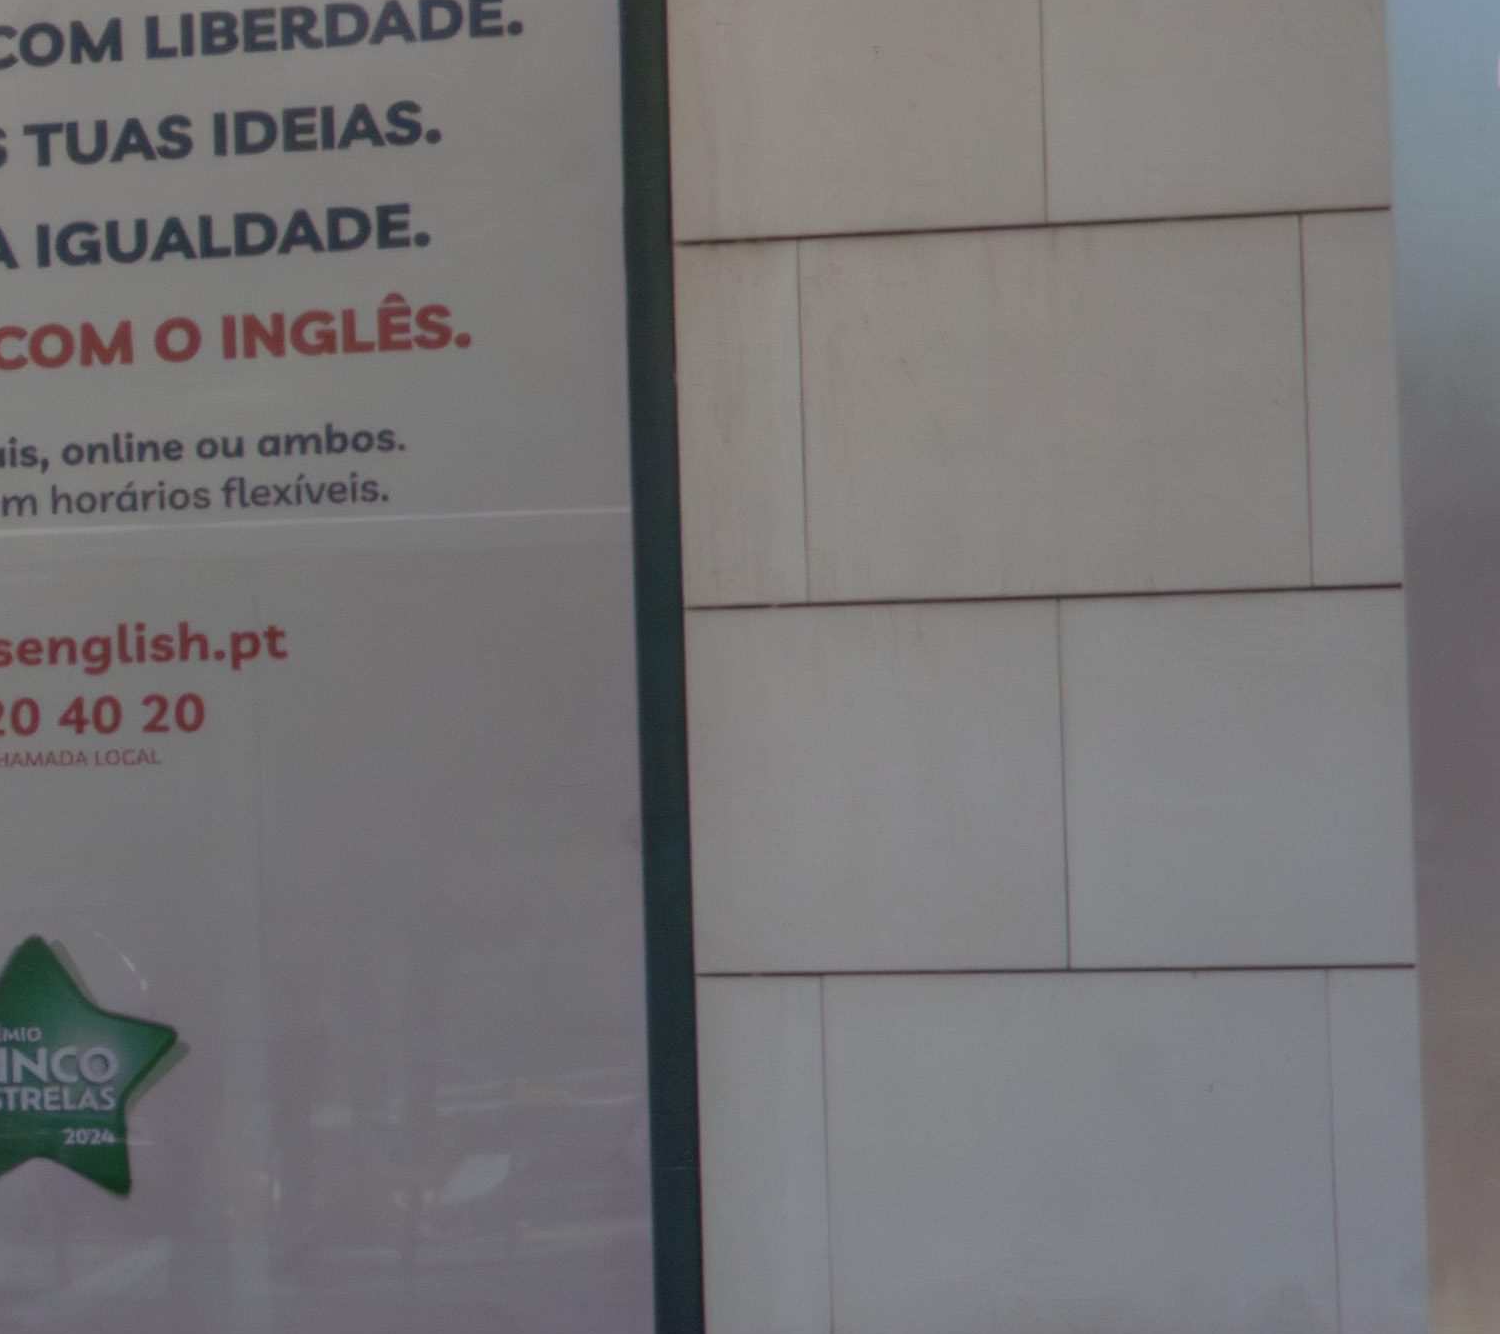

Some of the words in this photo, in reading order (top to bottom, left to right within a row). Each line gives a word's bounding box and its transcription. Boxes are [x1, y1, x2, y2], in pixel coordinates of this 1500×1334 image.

[22, 113, 195, 168] TUAS
[212, 99, 443, 158] IDEIAS.
[35, 201, 432, 269] IGUALDADE.
[153, 316, 203, 363] O
[221, 291, 473, 361] INGLÊS.
[61, 431, 184, 467] online
[195, 436, 245, 460] ou
[257, 422, 406, 458] ambos.
[51, 480, 212, 516] horários
[221, 471, 390, 509] flexíveis.
[58, 694, 124, 736] 40
[142, 692, 207, 735] 20
[94, 747, 163, 767] LOCAL
[62, 1127, 117, 1145] 2024
